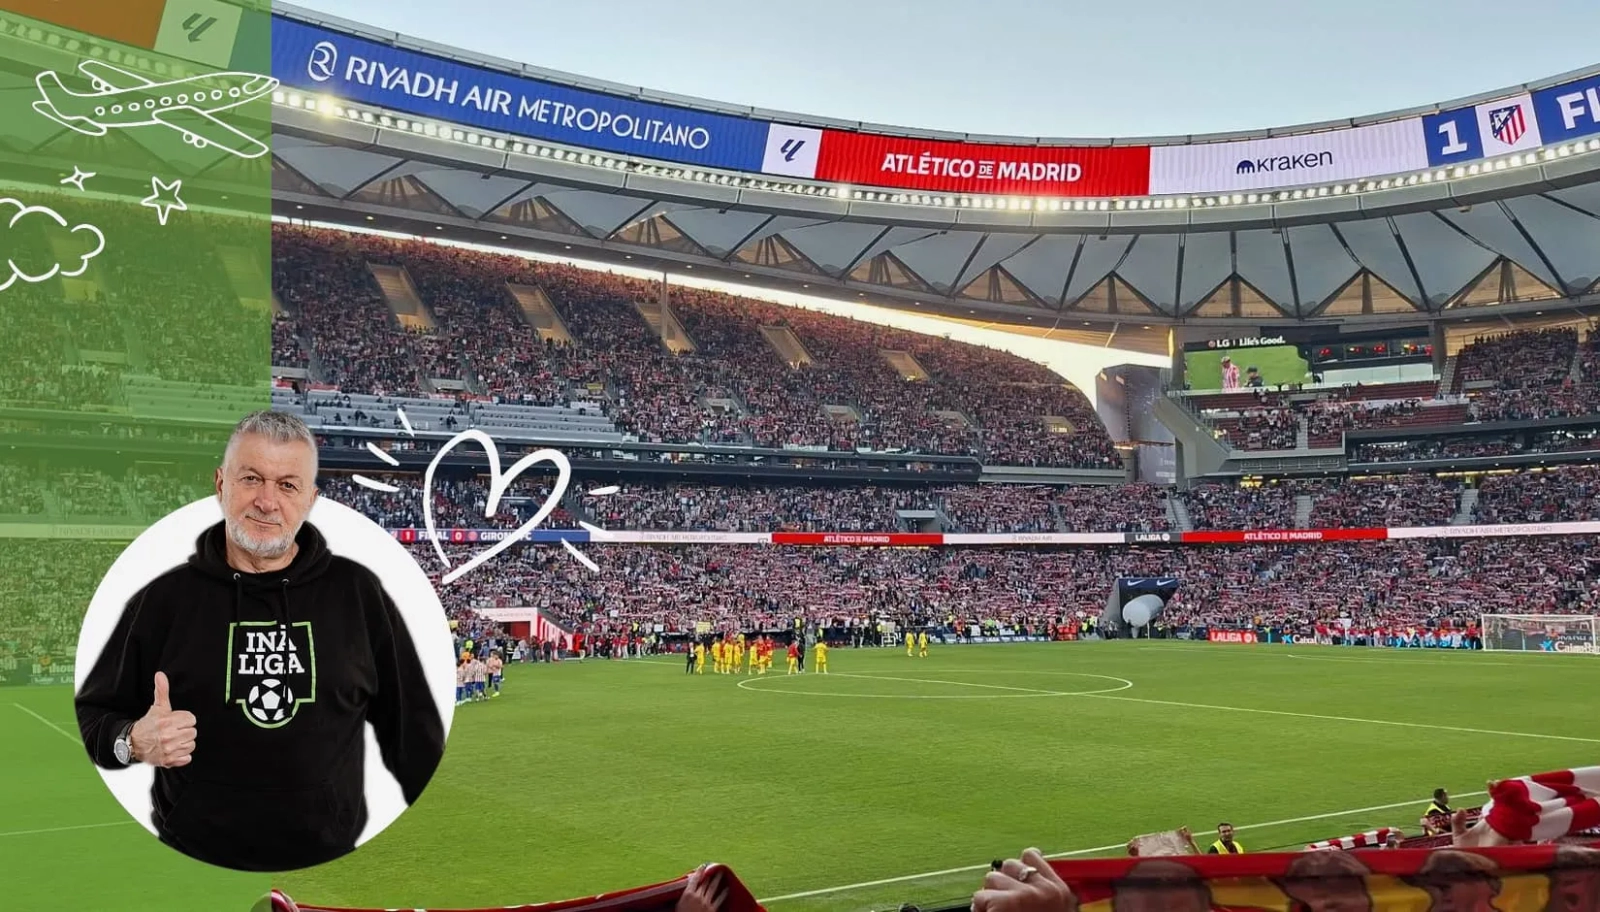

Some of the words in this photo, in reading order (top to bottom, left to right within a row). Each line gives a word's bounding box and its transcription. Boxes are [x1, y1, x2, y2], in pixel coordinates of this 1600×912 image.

[345, 55, 459, 104] RIYADH
[461, 84, 512, 116] AIR
[518, 94, 710, 151] METROPOLITANO
[1438, 120, 1467, 155] 1
[881, 151, 975, 179] ATLÉTICO
[978, 163, 994, 177] DE
[996, 162, 1082, 182] MADRID
[1216, 339, 1230, 348] LG
[418, 531, 449, 541] FIAL
[862, 535, 890, 543] MADRID
[1135, 534, 1161, 542] LALIGA
[1243, 531, 1281, 540] ATLÉTICO
[1289, 532, 1323, 540] MADRID
[1210, 631, 1242, 643] LALIGA
[238, 653, 305, 675] LIGA
